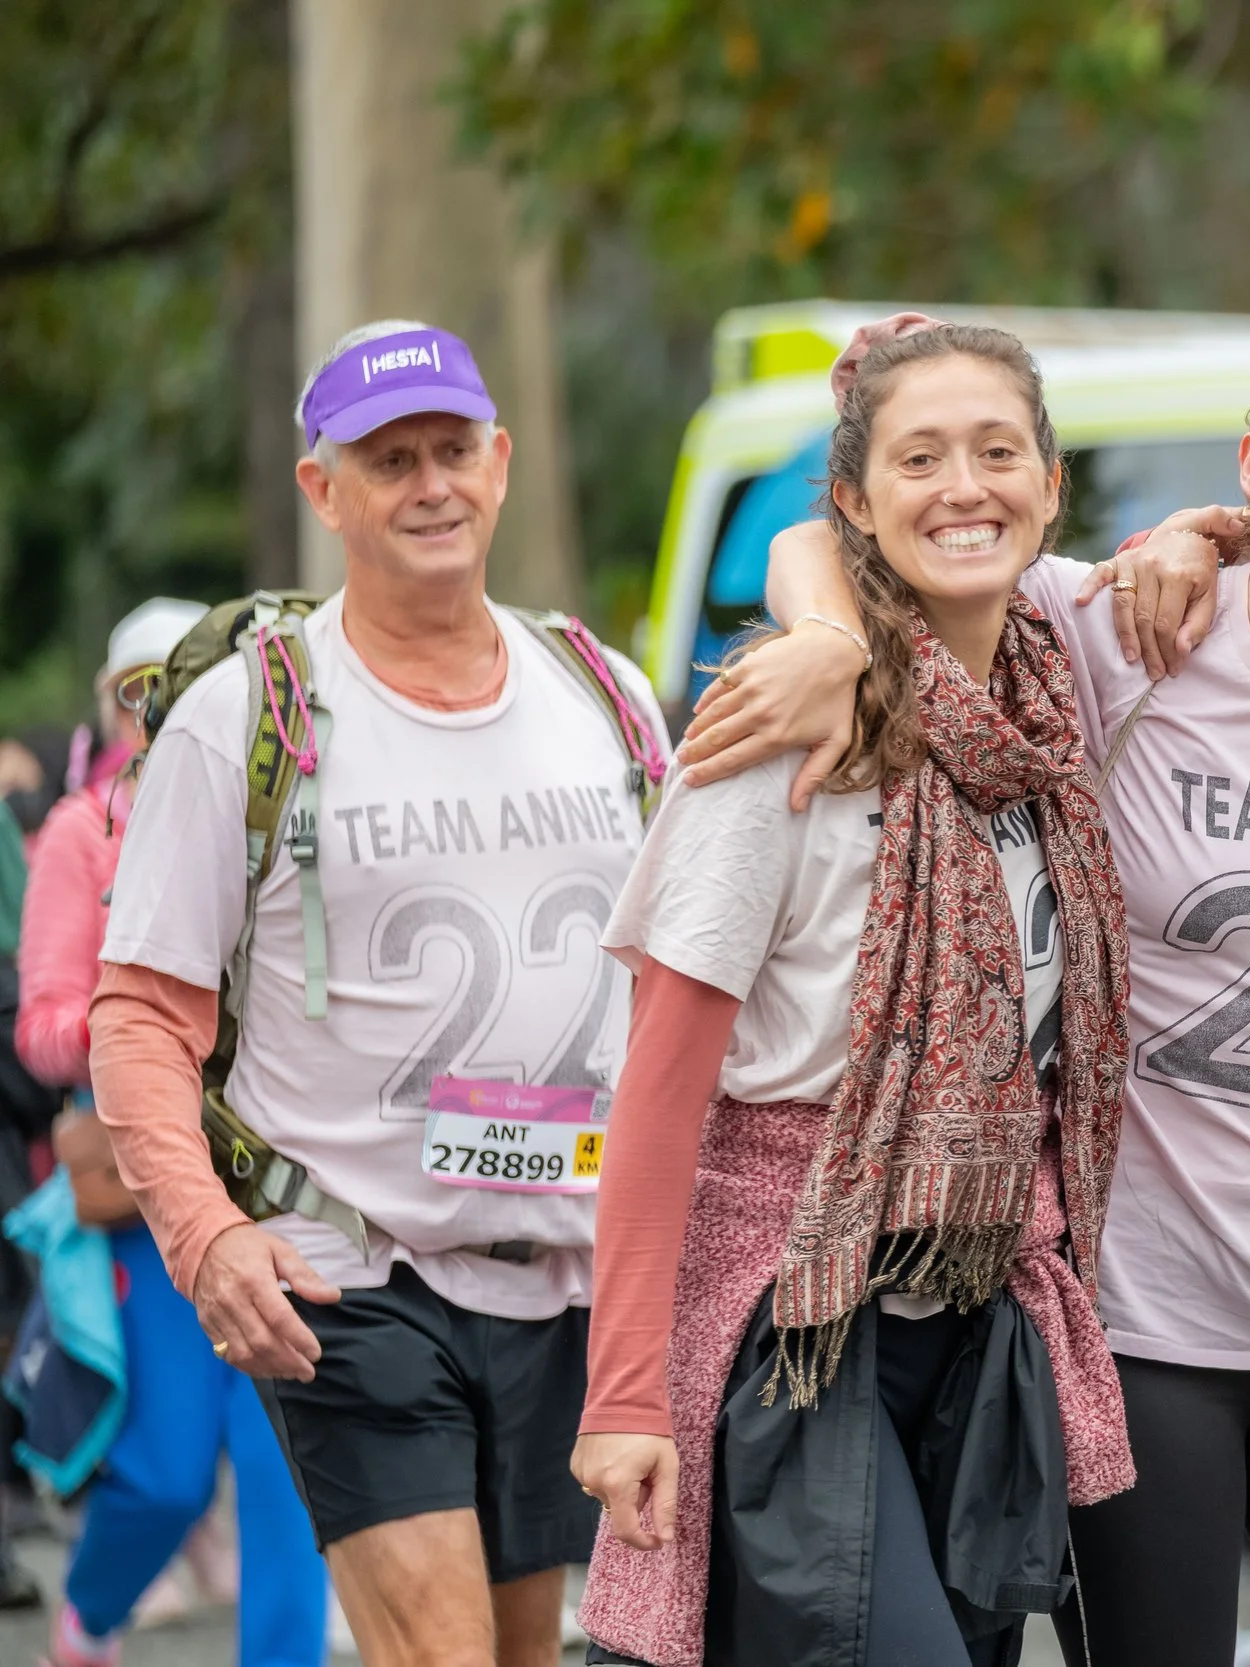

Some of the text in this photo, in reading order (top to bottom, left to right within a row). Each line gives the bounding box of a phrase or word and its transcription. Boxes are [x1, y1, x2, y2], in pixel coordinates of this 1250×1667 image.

[372, 346, 432, 374] HESTA
[334, 786, 626, 865] TEAM ANNIE
[368, 868, 618, 1122] 22
[483, 1124, 531, 1143] ANT
[583, 1136, 596, 1155] 4
[431, 1145, 563, 1181] 278899
[578, 1163, 599, 1174] KM
